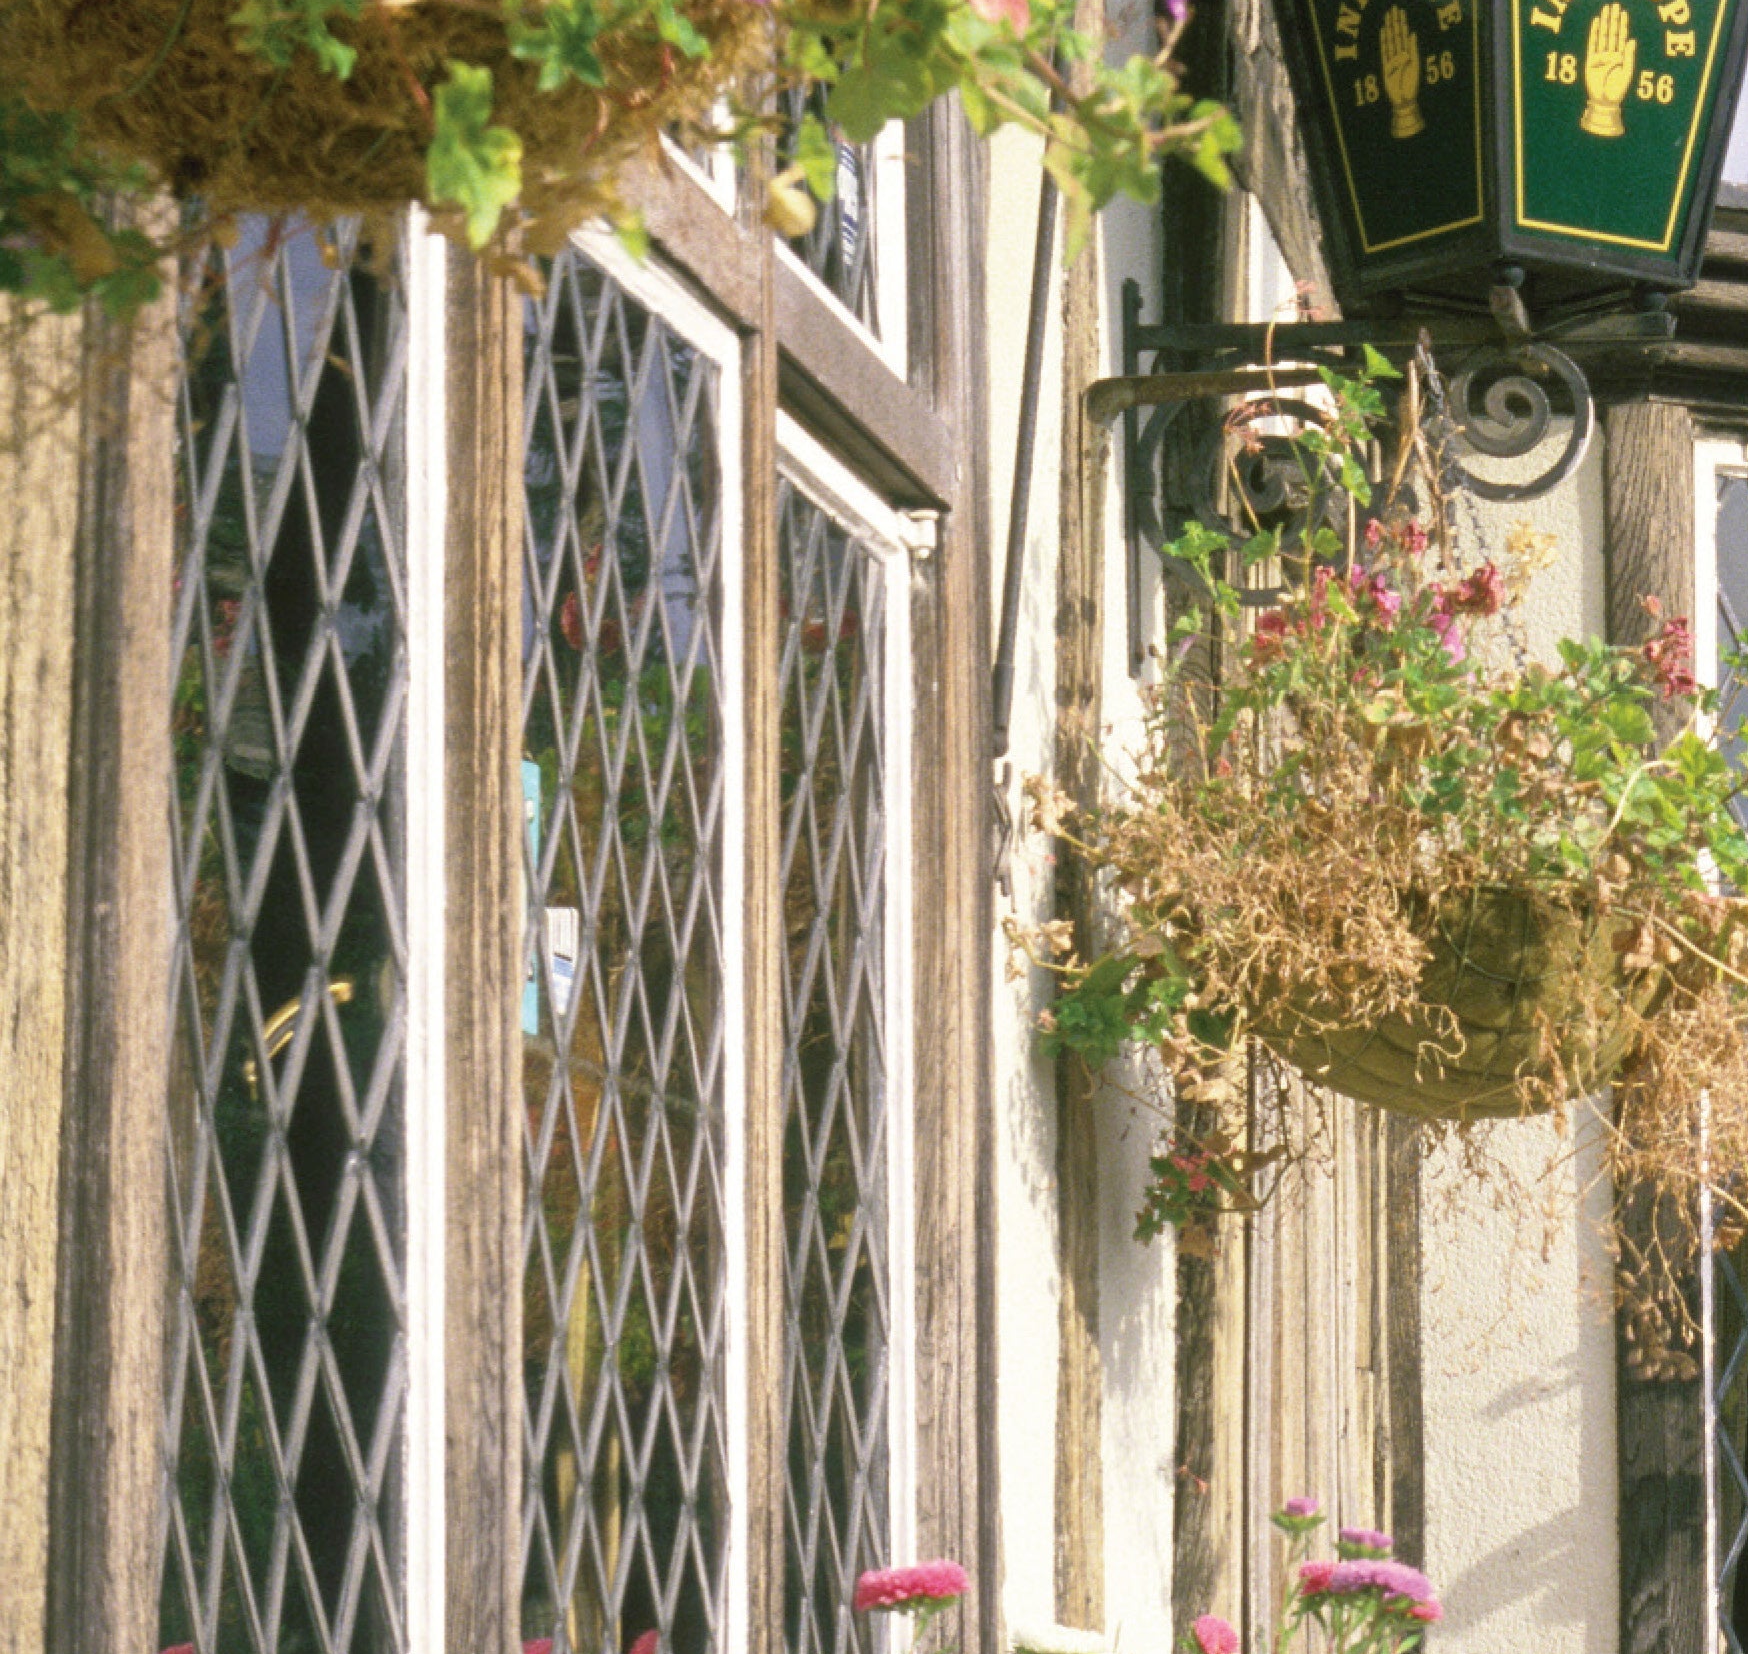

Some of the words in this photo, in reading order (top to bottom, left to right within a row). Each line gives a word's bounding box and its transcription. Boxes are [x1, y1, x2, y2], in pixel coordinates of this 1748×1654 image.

[1355, 75, 1379, 106] 18
[1426, 51, 1454, 84] 56
[1546, 51, 1577, 83] 18
[1637, 70, 1674, 104] 56
